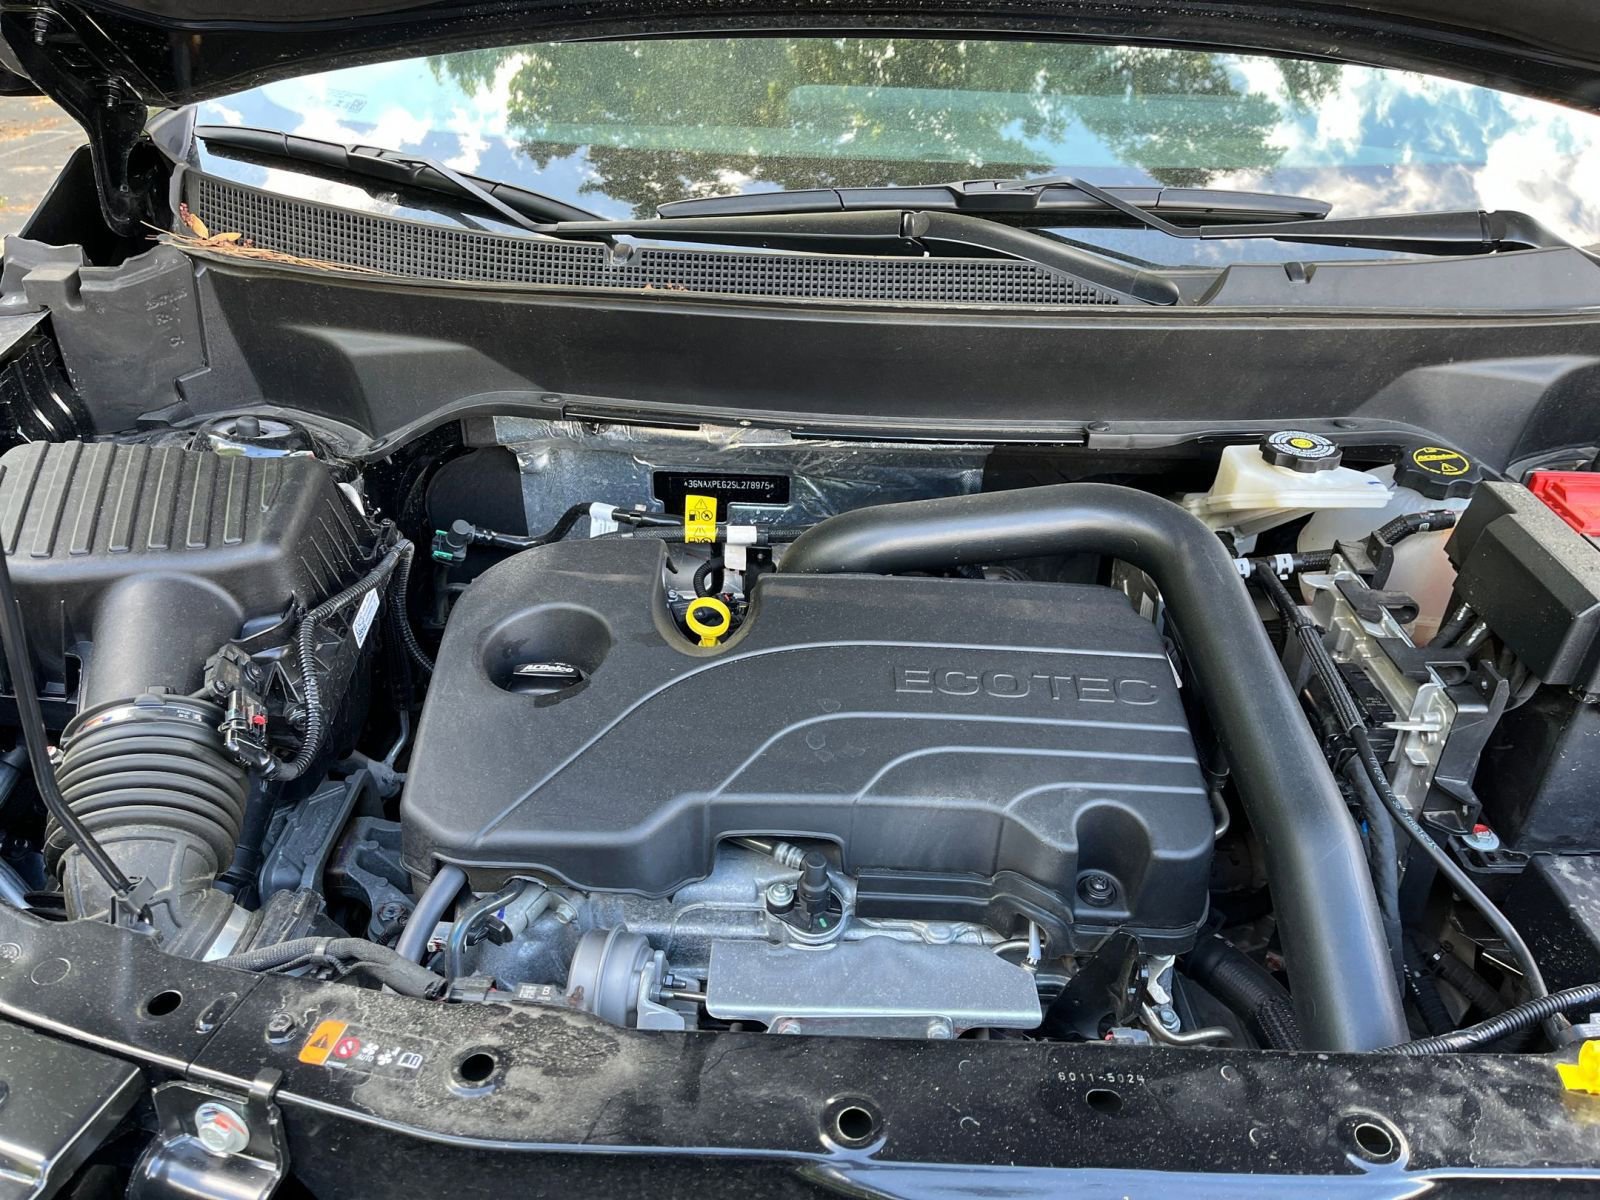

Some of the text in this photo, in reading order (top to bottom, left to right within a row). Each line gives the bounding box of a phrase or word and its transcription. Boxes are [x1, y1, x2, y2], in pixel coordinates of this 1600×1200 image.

[520, 664, 574, 673] ACDelco
[893, 665, 1160, 706] ECOTEC
[1058, 1071, 1145, 1084] 6011-5024
